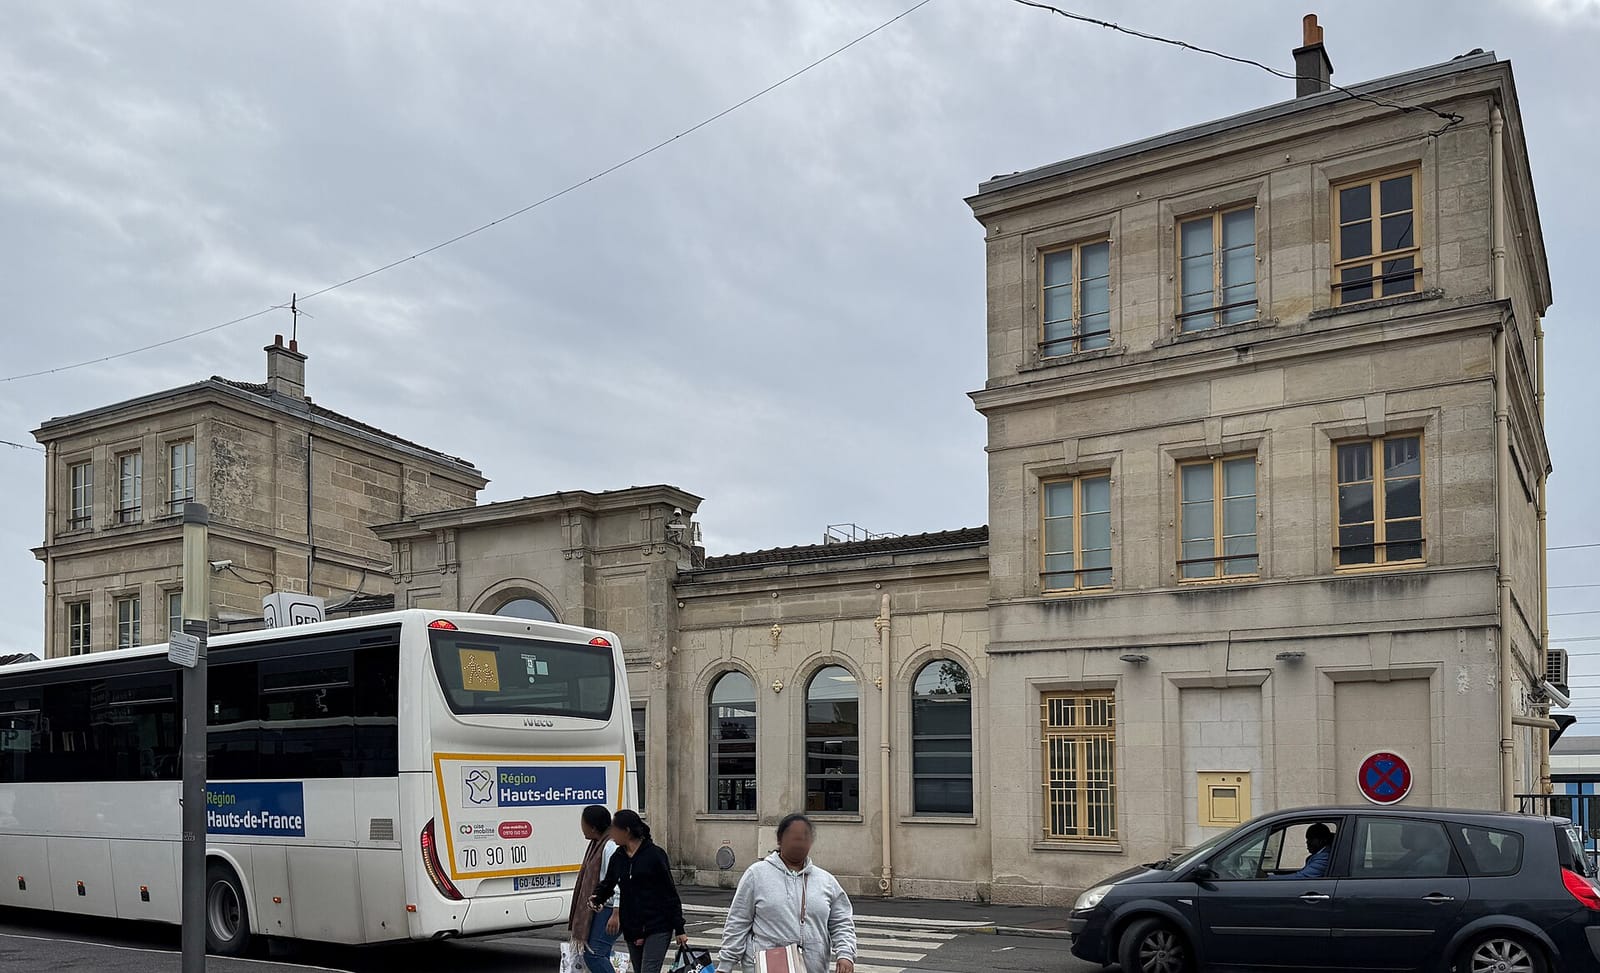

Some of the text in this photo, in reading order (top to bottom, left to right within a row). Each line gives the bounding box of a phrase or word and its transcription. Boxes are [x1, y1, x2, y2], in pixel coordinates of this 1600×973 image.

[523, 718, 553, 727] IVECO
[500, 773, 536, 786] Région
[206, 791, 236, 807] Région
[501, 787, 604, 802] Hauts-de-France
[207, 810, 302, 830] Hauts-de-France
[463, 845, 527, 868] 70 90 100
